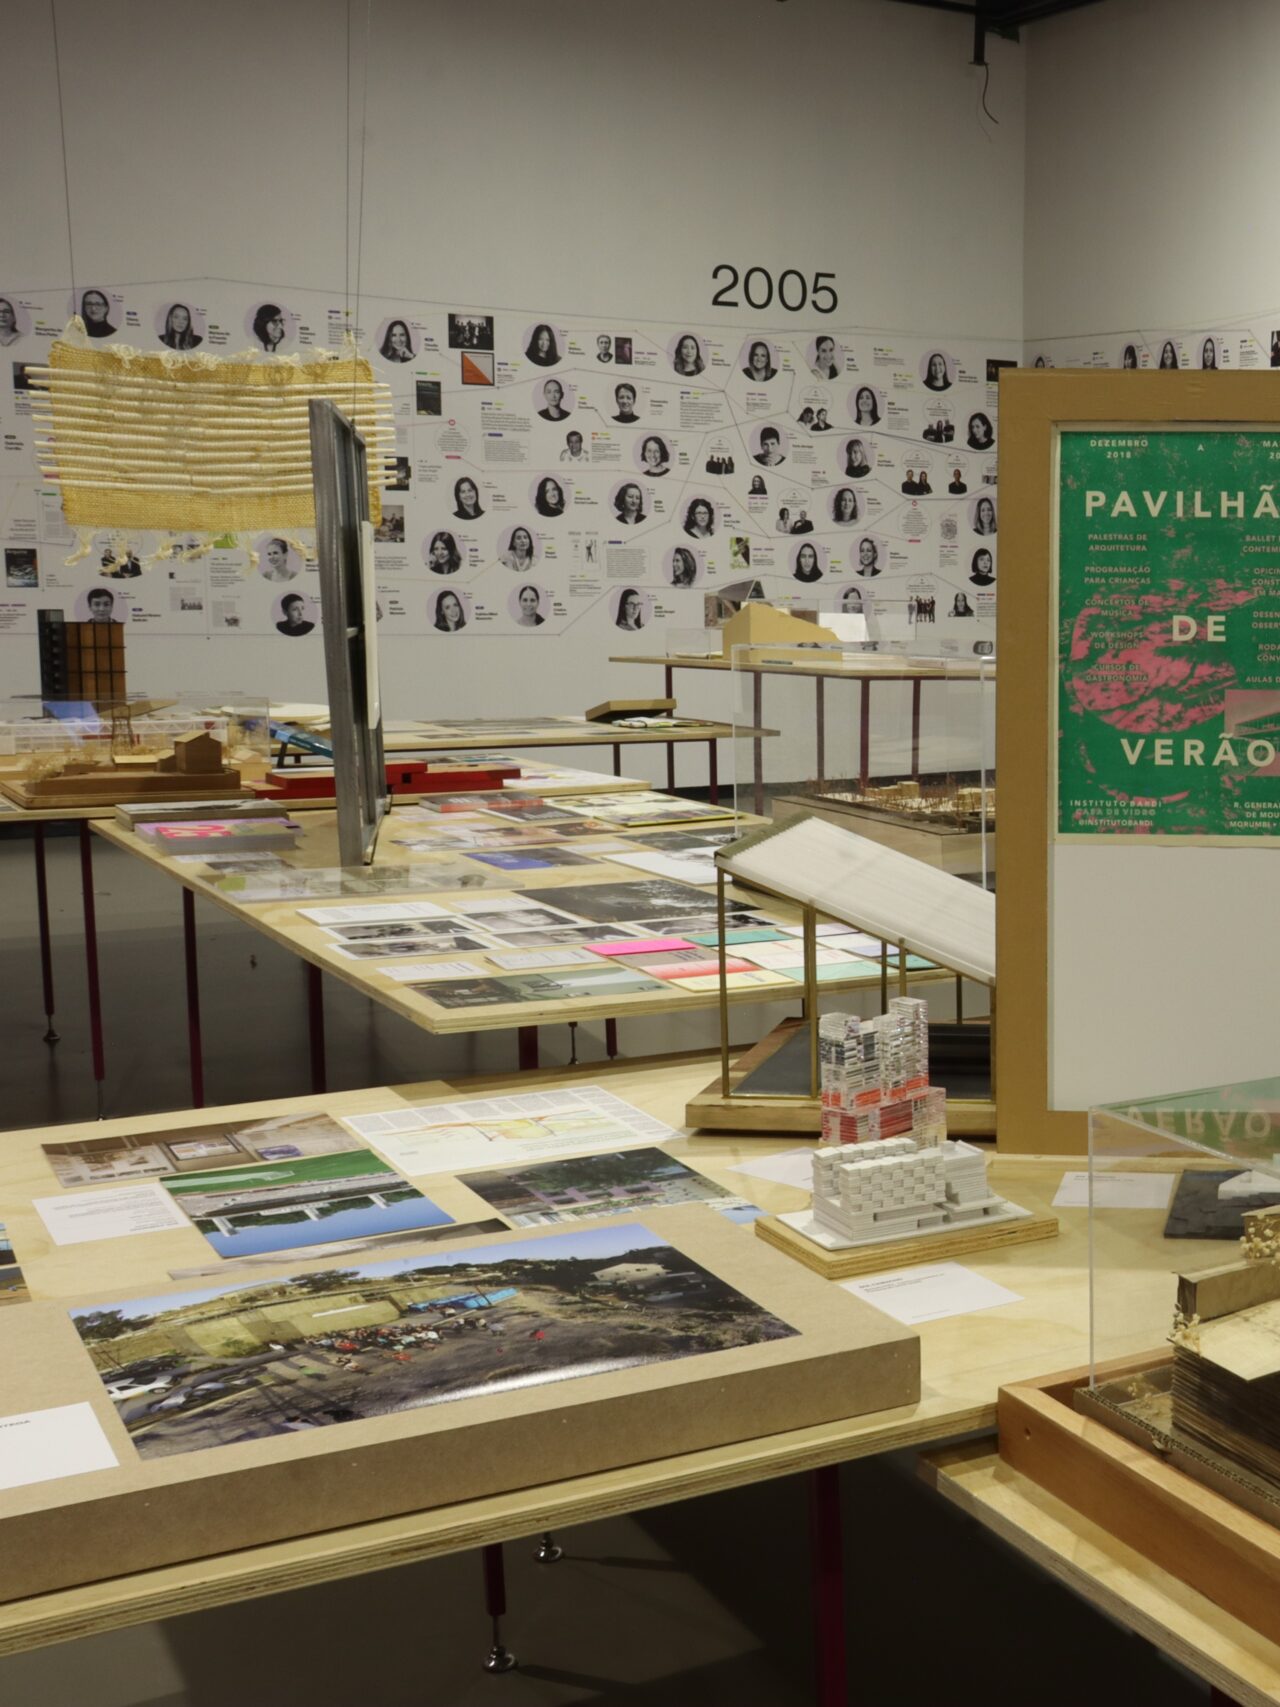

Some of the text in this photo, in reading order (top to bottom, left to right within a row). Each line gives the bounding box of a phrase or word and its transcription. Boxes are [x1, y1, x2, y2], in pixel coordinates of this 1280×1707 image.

[711, 264, 839, 314] 2005
[1089, 439, 1148, 448] DEZEMBRO
[1106, 451, 1132, 459] 2018
[1088, 533, 1148, 541] PALESTRAS DE
[1088, 544, 1148, 552] ARQUITETURA
[1084, 565, 1151, 574] PROGRAMAÇÃO
[1108, 577, 1151, 585] CRIANÇAS
[1085, 598, 1136, 606] CONCERTOS
[1101, 608, 1134, 616] MÚSICA
[1171, 615, 1227, 642] DE
[1090, 631, 1144, 639] WORKSHOPS
[1120, 732, 1276, 767] VERÃO
[1069, 799, 1162, 809] INSTITUTO BARDI
[1245, 811, 1257, 819] DE
